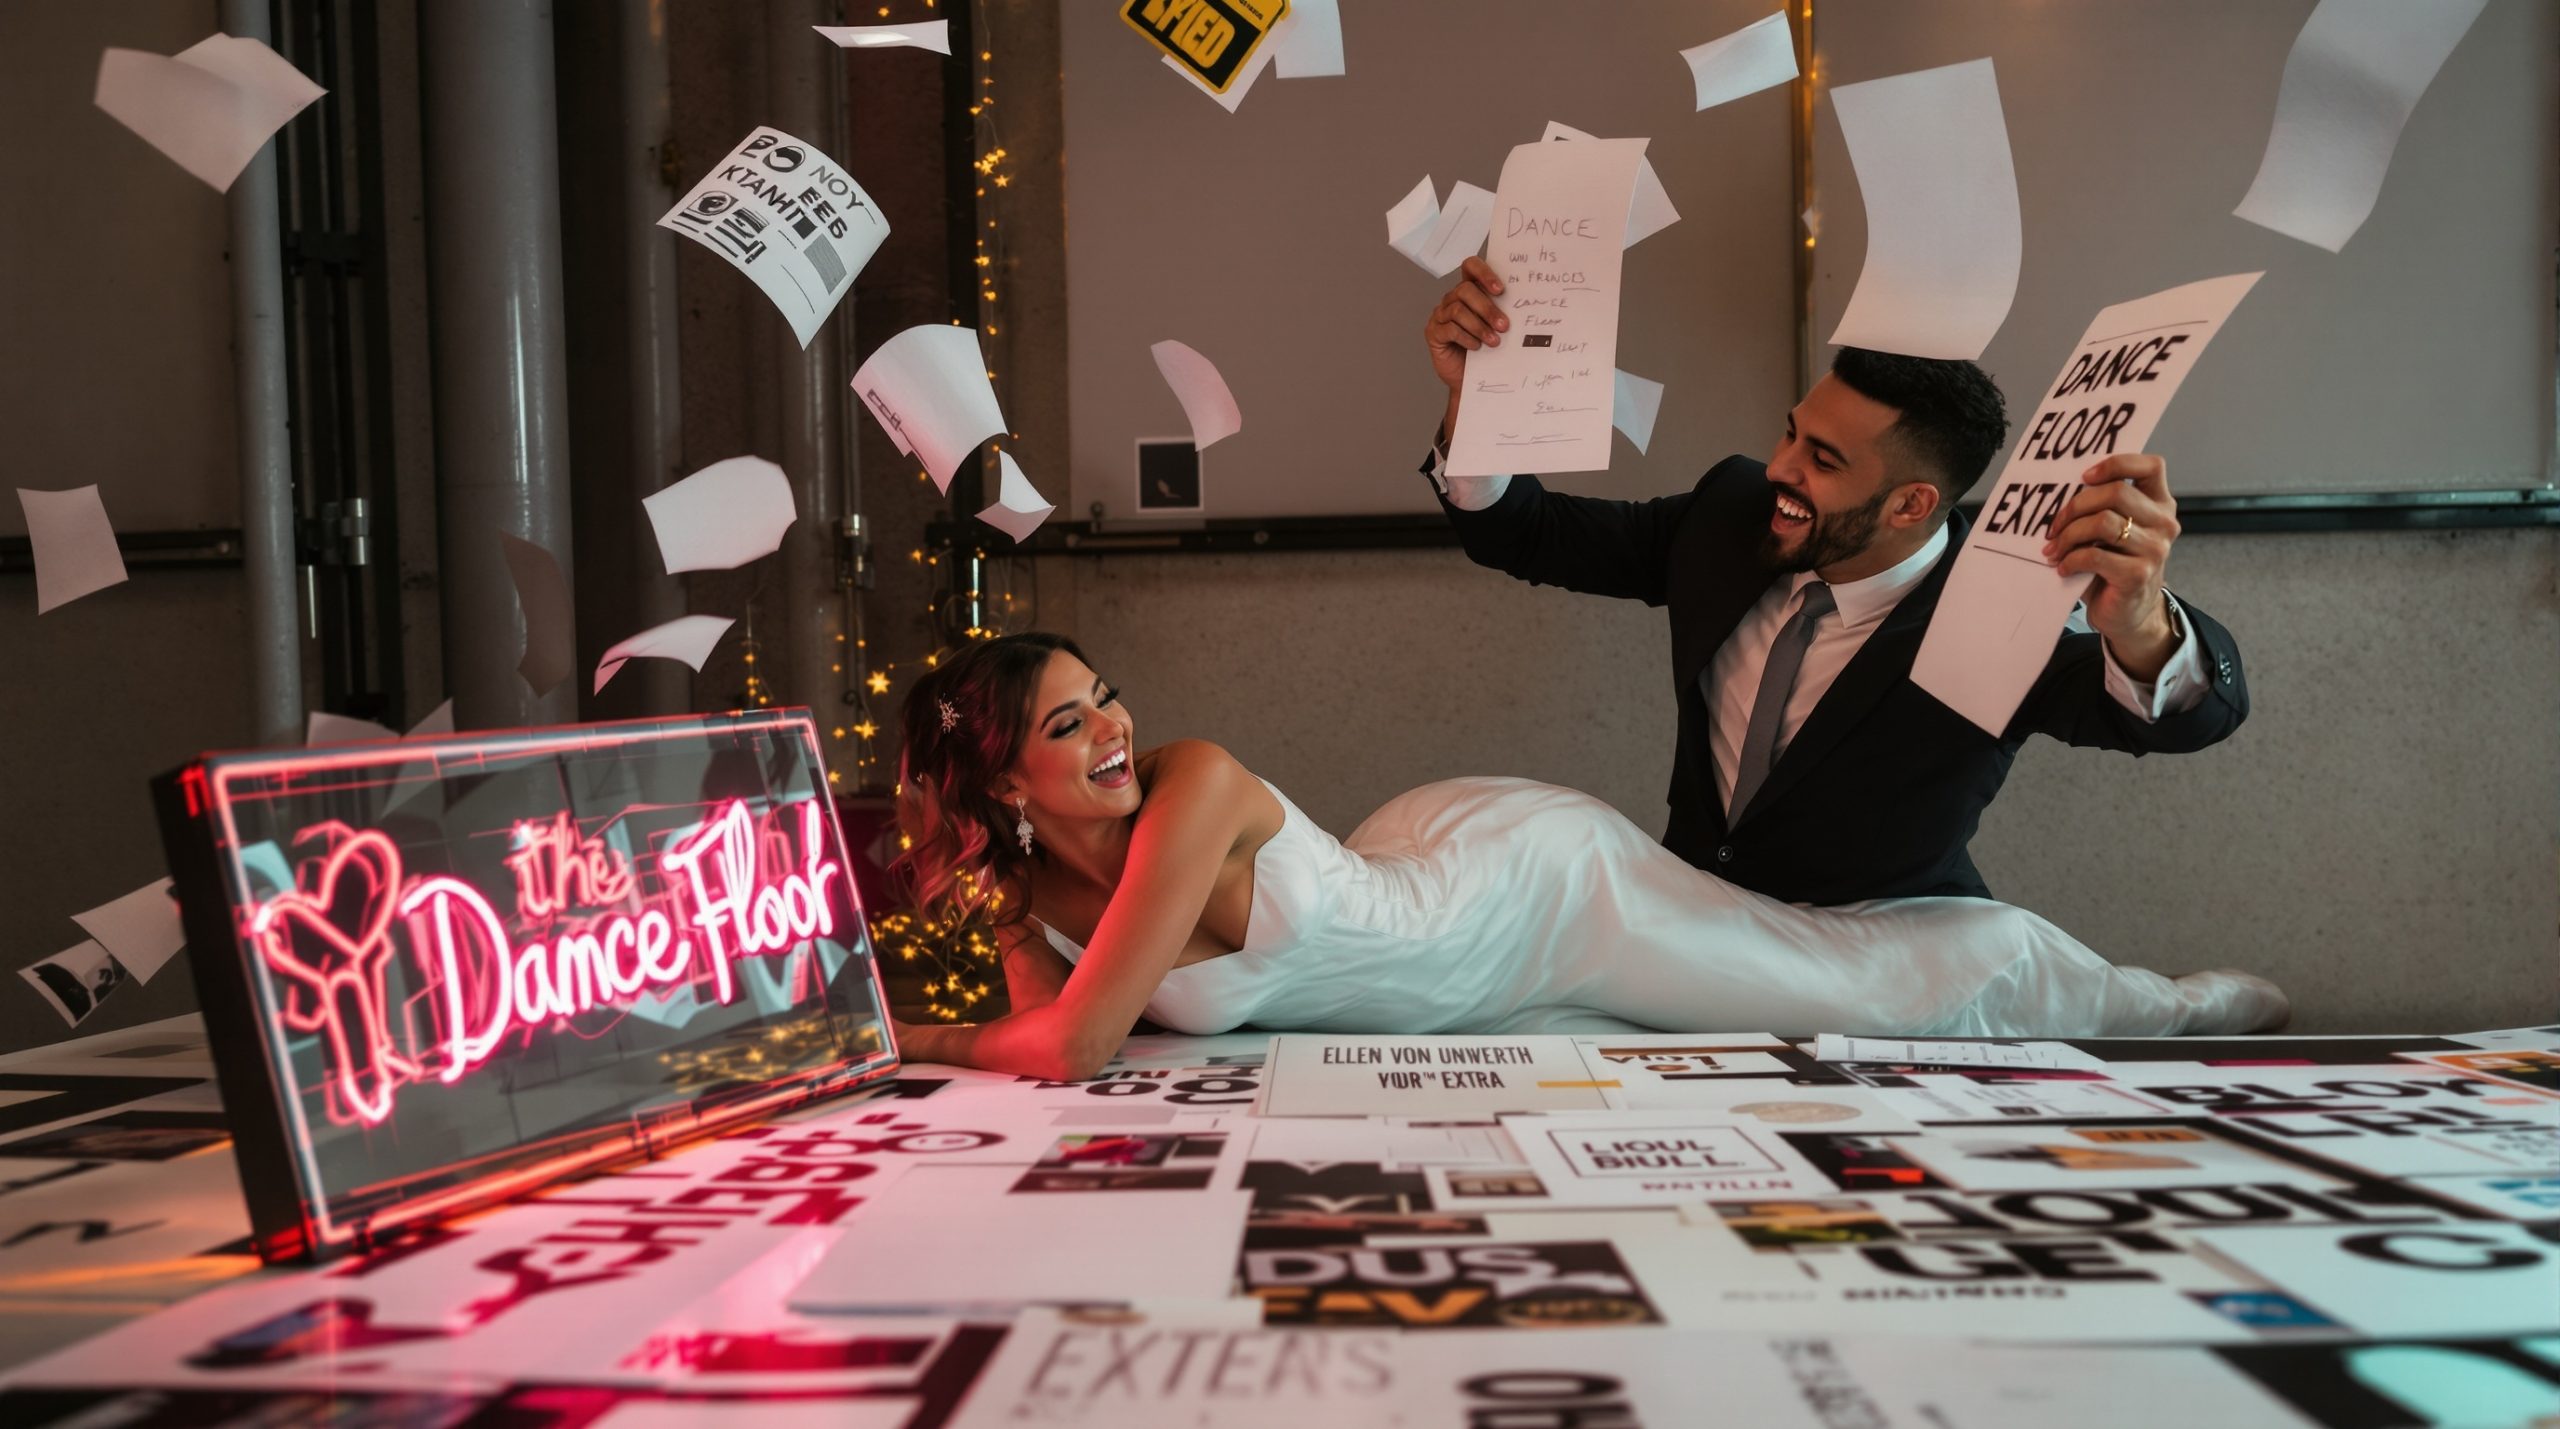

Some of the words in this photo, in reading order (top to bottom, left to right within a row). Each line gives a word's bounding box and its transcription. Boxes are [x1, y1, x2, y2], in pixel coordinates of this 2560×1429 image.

[1507, 207, 1599, 239] DANCE
[2053, 335, 2191, 399] DANCE
[2020, 403, 2137, 461] FLOOR
[1984, 483, 2085, 540] EXTA
[505, 812, 636, 916] the
[400, 876, 692, 1082] Dance
[662, 798, 840, 1004] Floor
[1323, 1047, 1382, 1065] ELLEN
[1390, 1047, 1432, 1065] VON
[1438, 1046, 1534, 1065] UNWERTH
[1441, 1071, 1506, 1090] EXTRA
